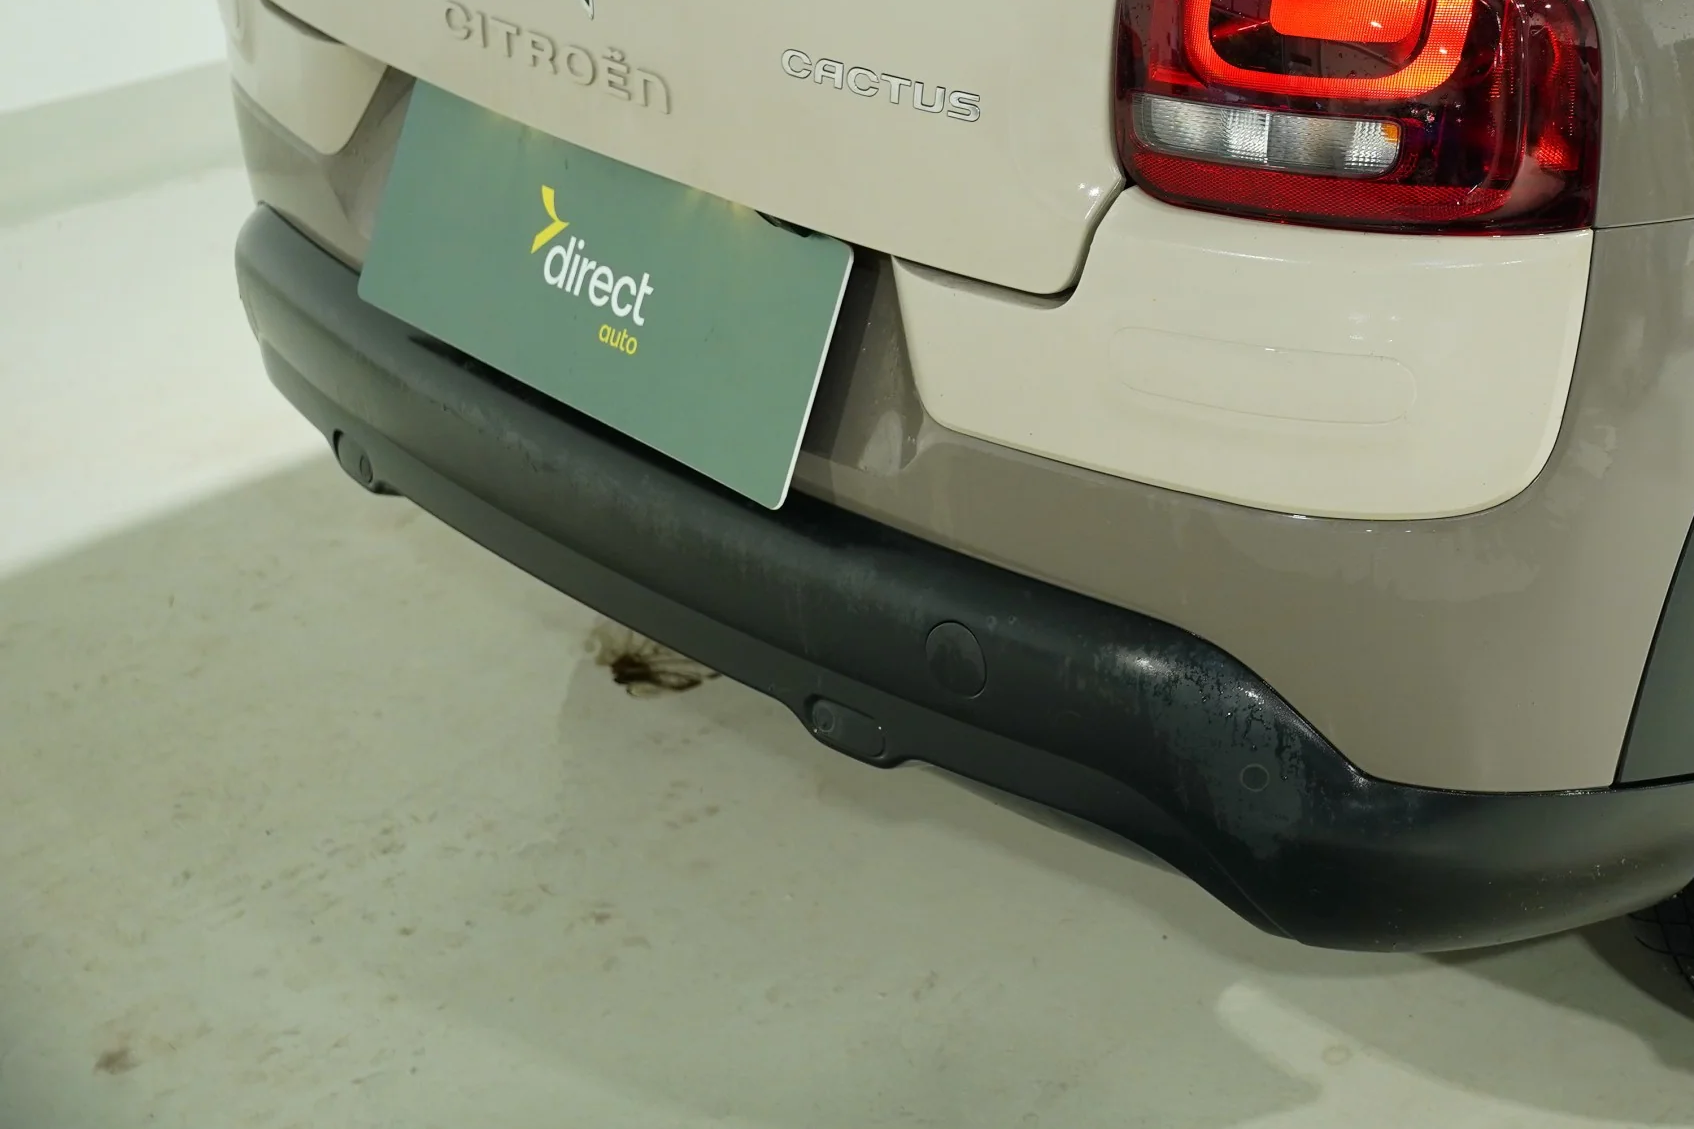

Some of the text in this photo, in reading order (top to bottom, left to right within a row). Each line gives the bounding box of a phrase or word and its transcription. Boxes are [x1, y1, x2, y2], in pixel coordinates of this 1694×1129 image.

[781, 48, 981, 122] CACTUS
[543, 236, 654, 326] direct
[599, 323, 638, 355] auto
